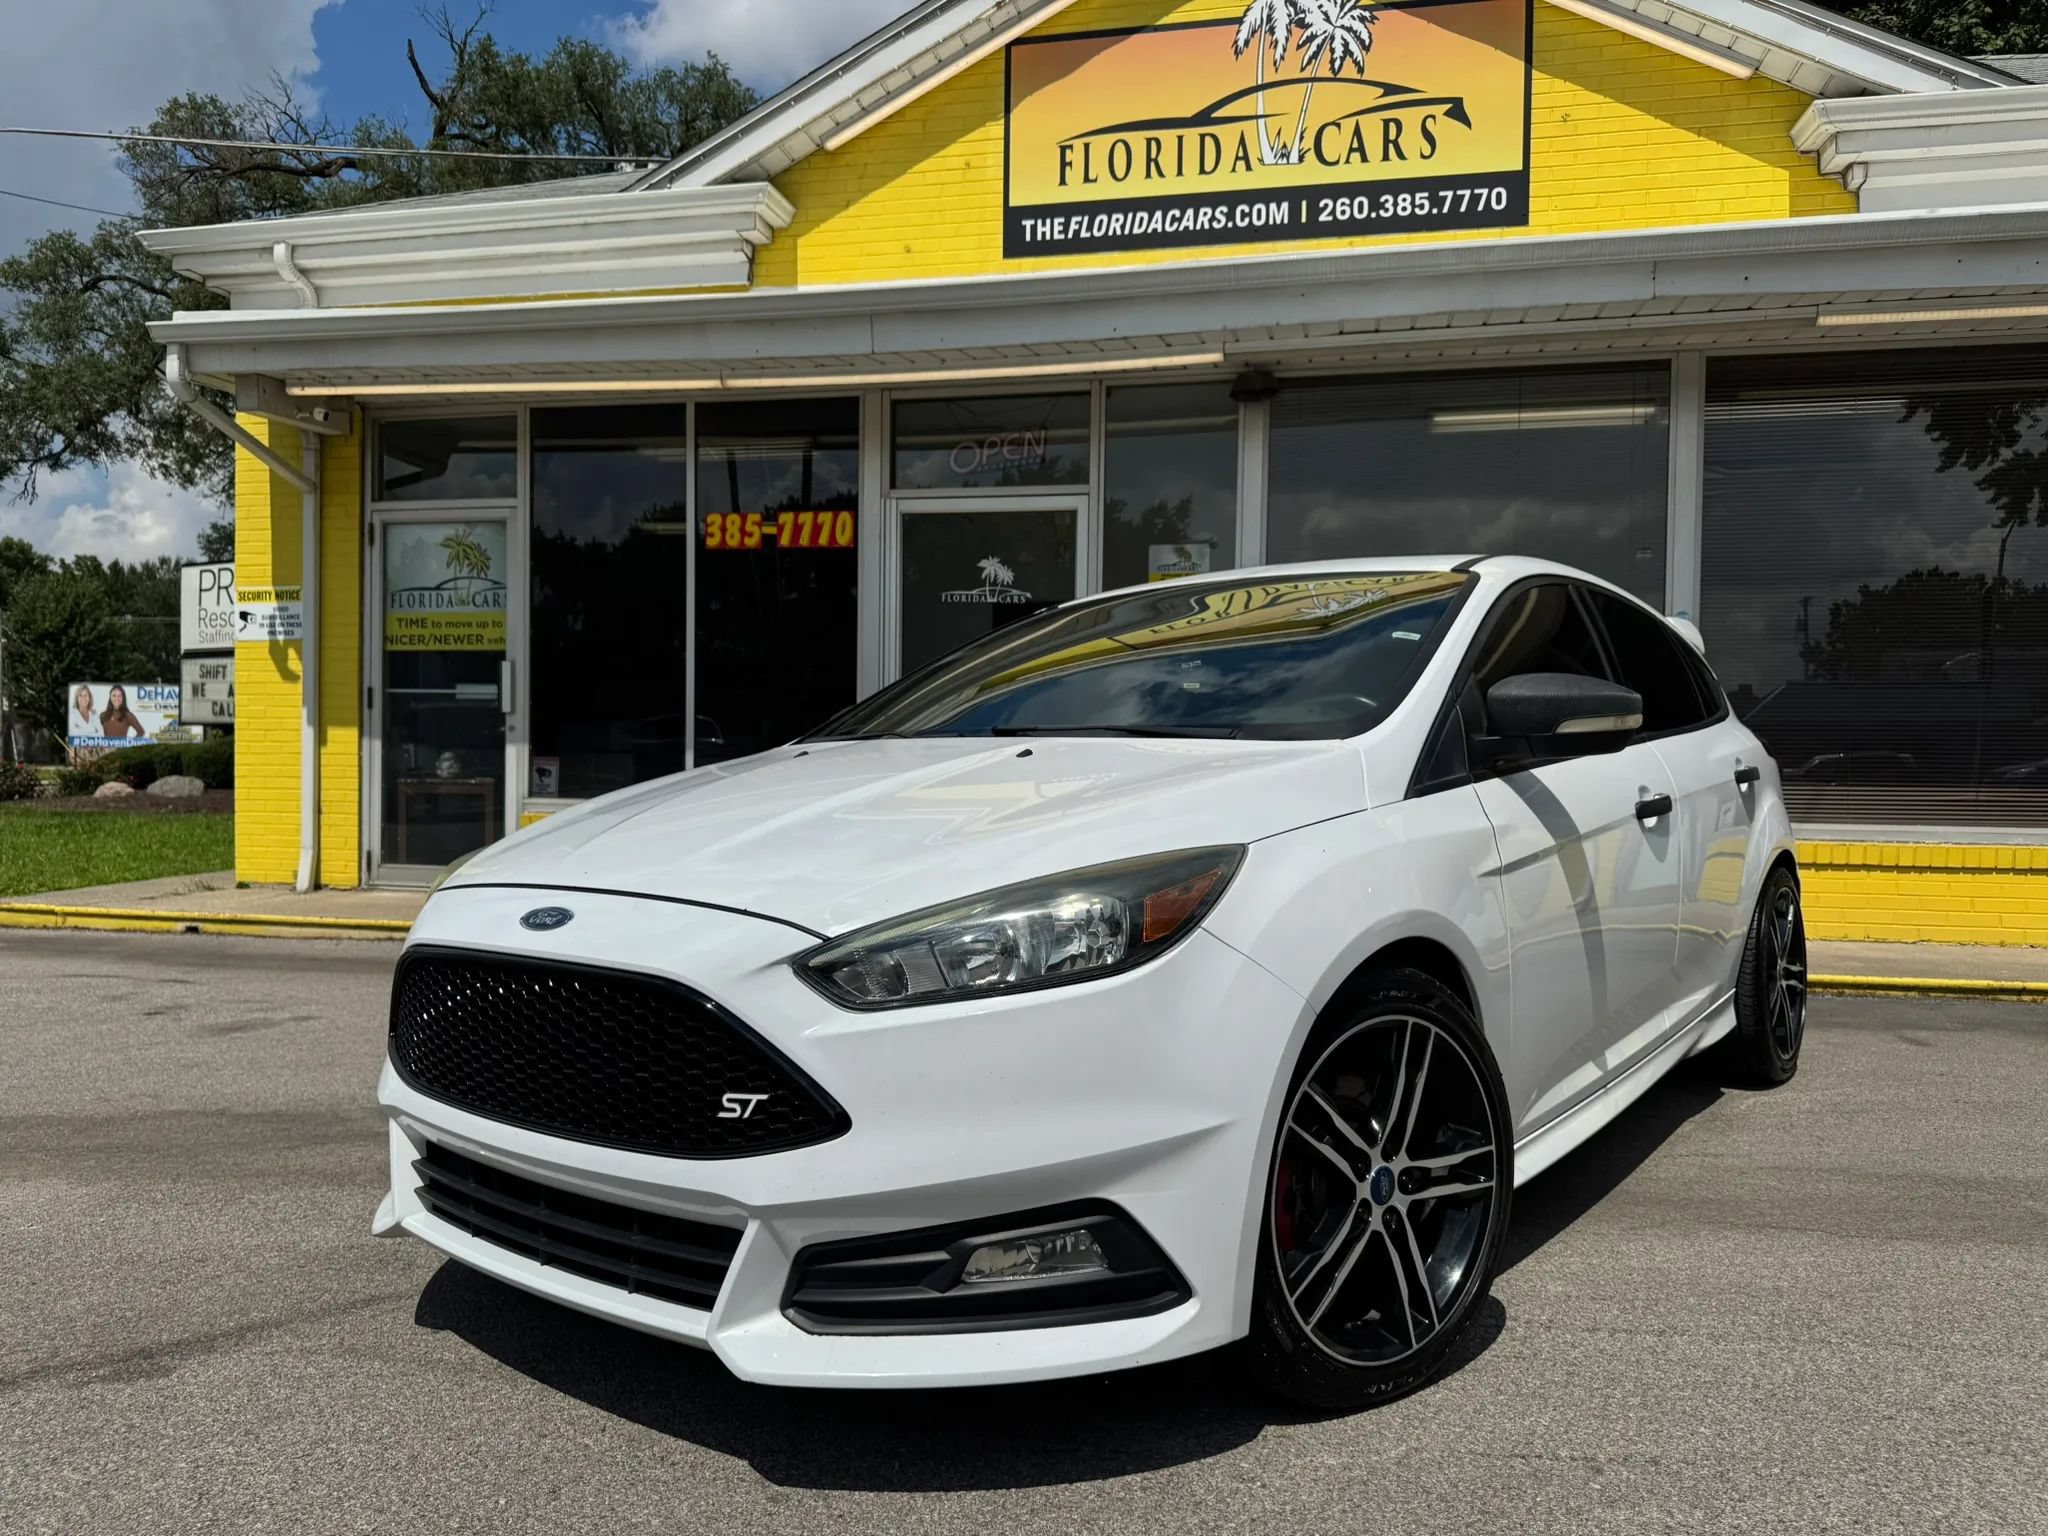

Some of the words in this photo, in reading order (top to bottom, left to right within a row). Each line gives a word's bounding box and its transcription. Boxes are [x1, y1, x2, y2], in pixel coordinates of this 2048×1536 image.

[1057, 129, 1254, 187] FLORIDA
[1313, 113, 1438, 167] CARS
[1021, 200, 1290, 242] THEFLORIDACARS.COM
[1317, 186, 1509, 223] 260.385.7770
[948, 428, 1047, 475] OPEN
[705, 510, 854, 548] 385-7770
[238, 590, 272, 602] SECURITY
[275, 589, 301, 601] NOTICE
[390, 591, 455, 609] FLORIDA
[941, 592, 986, 603] FLORIDA
[999, 594, 1027, 604] CARS
[396, 616, 428, 629] TIME
[432, 620, 442, 629] to
[445, 620, 472, 629] move
[476, 620, 489, 631] up
[493, 619, 503, 629] to
[384, 633, 485, 647] NICER/NEWER
[199, 663, 228, 681] SHIFT
[191, 682, 206, 699] WE
[716, 1092, 770, 1119] ST
